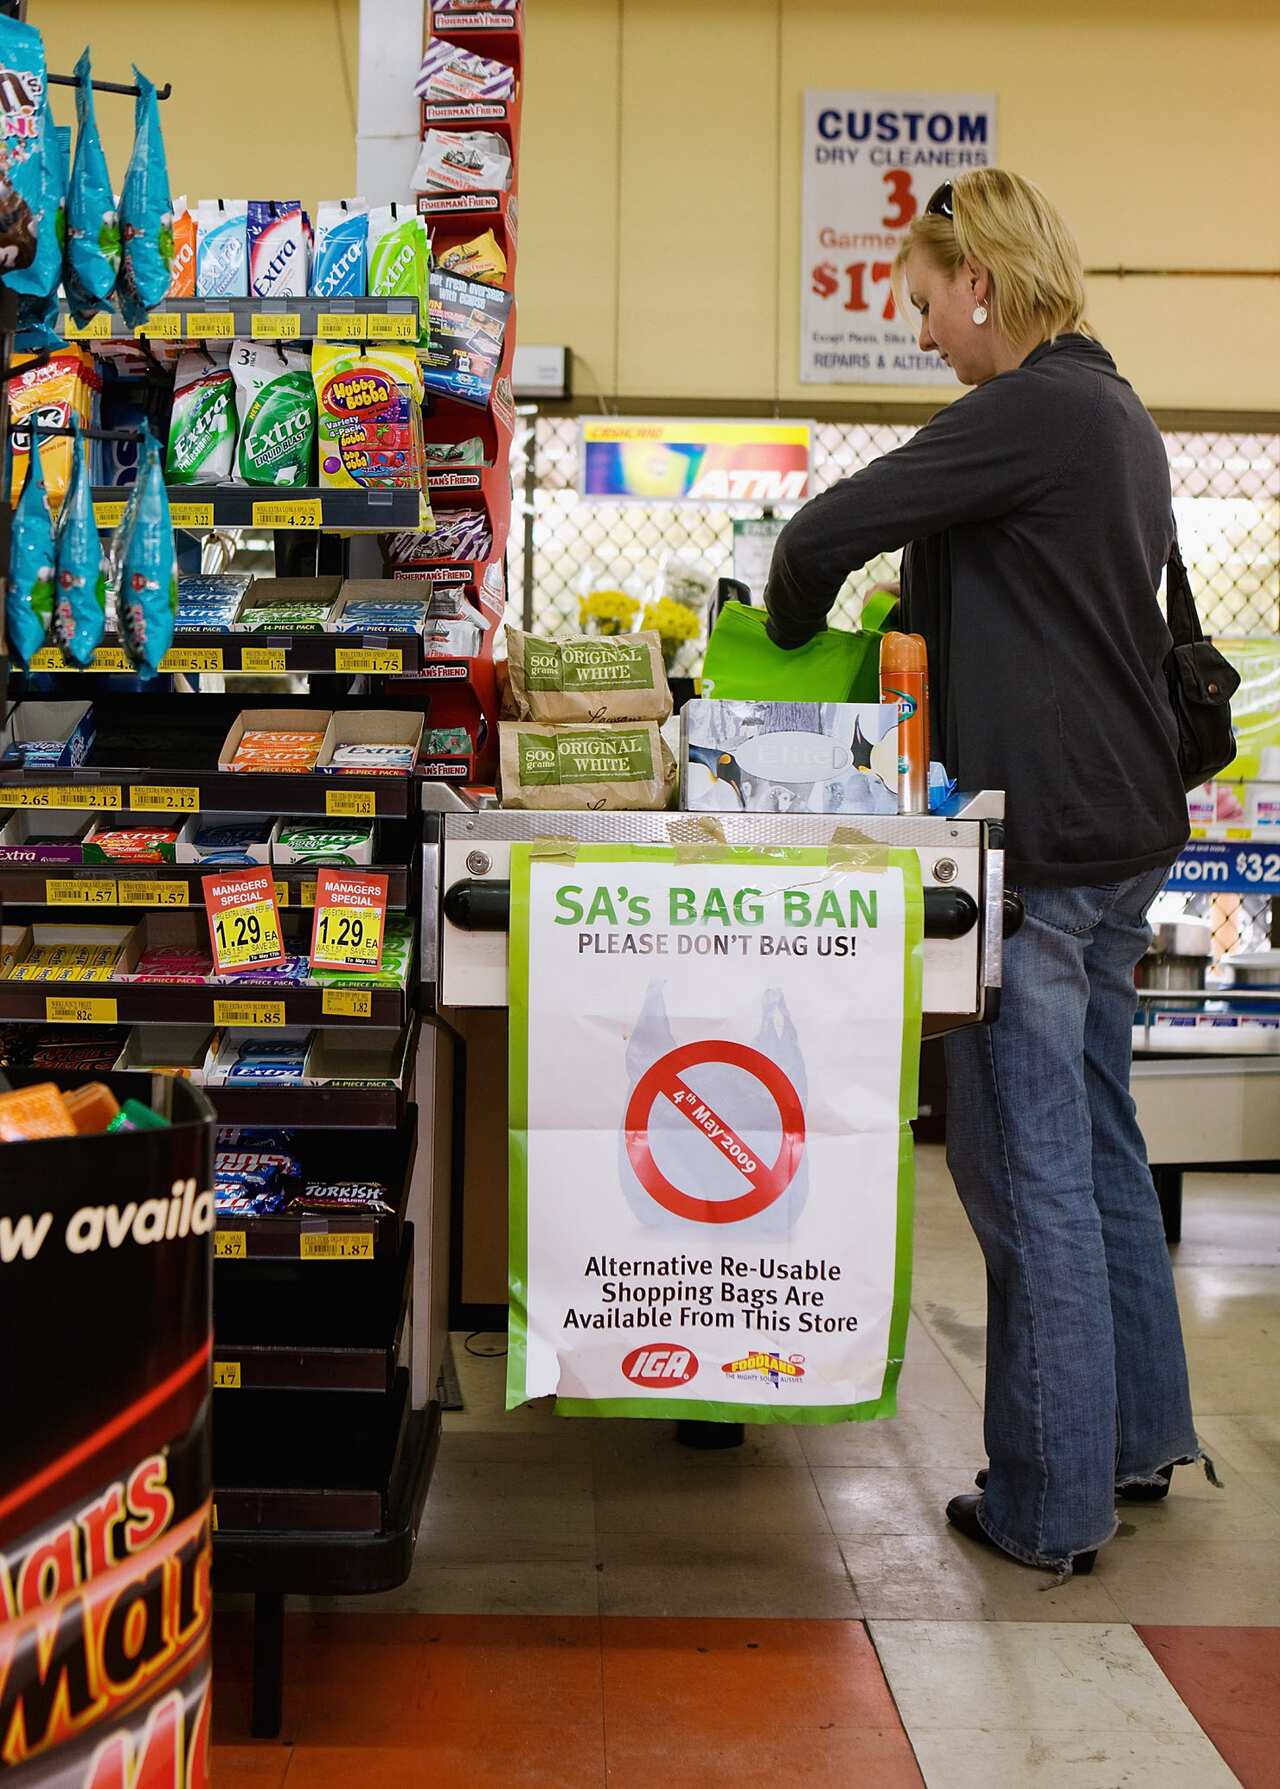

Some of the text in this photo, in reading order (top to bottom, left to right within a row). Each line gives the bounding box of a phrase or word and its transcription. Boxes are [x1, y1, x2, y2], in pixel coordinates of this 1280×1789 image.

[428, 105, 504, 118] FISHERMAN'S FRIEND
[817, 109, 988, 144] CUSTOM
[815, 147, 989, 167] DRY CLEANERS
[420, 197, 497, 210] FISHERMAN'S FRIEND
[881, 169, 918, 229] 3
[819, 227, 897, 249] Garme
[253, 239, 297, 297] Extra
[314, 240, 362, 297] Extra
[371, 244, 416, 297] Extra
[237, 349, 251, 366] 3
[813, 353, 871, 369] REPAIRS
[893, 355, 950, 370] ALTERA
[333, 379, 377, 400] Hubba
[346, 387, 389, 410] Bubba
[248, 401, 262, 420] NEW
[174, 394, 230, 461] Extra
[326, 415, 360, 430] Variety
[244, 407, 312, 460] Extra
[255, 431, 306, 467] LIQUID BLAST
[450, 474, 479, 485] FRIEND
[687, 470, 809, 499] ATM
[287, 515, 315, 527] 4.22
[395, 568, 471, 580] FISHERMAN'S FRIEND
[357, 603, 418, 611] Extra
[530, 655, 559, 669] 800
[561, 649, 642, 665] ORIGINAL
[190, 659, 218, 670] 5.15
[270, 660, 285, 670] 1.75
[372, 660, 399, 671] 1.75
[530, 667, 559, 676] grams
[438, 667, 466, 677] FRIEND
[576, 664, 631, 681] WHITE
[252, 734, 317, 742] Extra
[347, 746, 412, 755] Extra
[558, 738, 642, 756] ORIGINAL
[245, 752, 311, 760] Extra
[525, 750, 555, 762] 800
[438, 766, 466, 775] FRIEND
[526, 761, 555, 770] grams
[573, 757, 630, 771] WHITE
[20, 795, 49, 806] 2.65
[88, 796, 117, 807] 2.12
[166, 797, 195, 808] 2.12
[355, 803, 371, 814] 1.82
[102, 832, 169, 840] Extra
[288, 834, 357, 842] Extra
[212, 879, 269, 897] MANAGERS
[324, 882, 382, 896] MANAGERS
[84, 891, 112, 902] 1.57
[156, 893, 185, 904] 1.57
[220, 891, 264, 907] SPECIAL
[330, 893, 373, 906] SPECIAL
[553, 884, 879, 929] SA's BAG BAN
[216, 915, 261, 949] 1.29
[264, 930, 278, 942] EA
[319, 916, 363, 947] 1.29
[365, 938, 378, 949] EA
[577, 933, 857, 957] PLEASE DON'T BAG US!
[352, 1002, 368, 1013] 1.82
[76, 1010, 92, 1021] 82c
[252, 1013, 281, 1024] 1.85
[237, 1068, 300, 1077] Extra
[672, 1090, 757, 1174] 4th May 2009
[305, 1184, 383, 1199] TURKISH
[340, 1244, 368, 1255] 1.87
[584, 1254, 841, 1281] Alternative Re-Usable
[601, 1281, 824, 1309] Shopping Bags Are
[563, 1307, 858, 1333] Available From This Store
[629, 1351, 688, 1379] IGA
[731, 1353, 797, 1375] FOODLAND
[215, 1371, 235, 1385] .17
